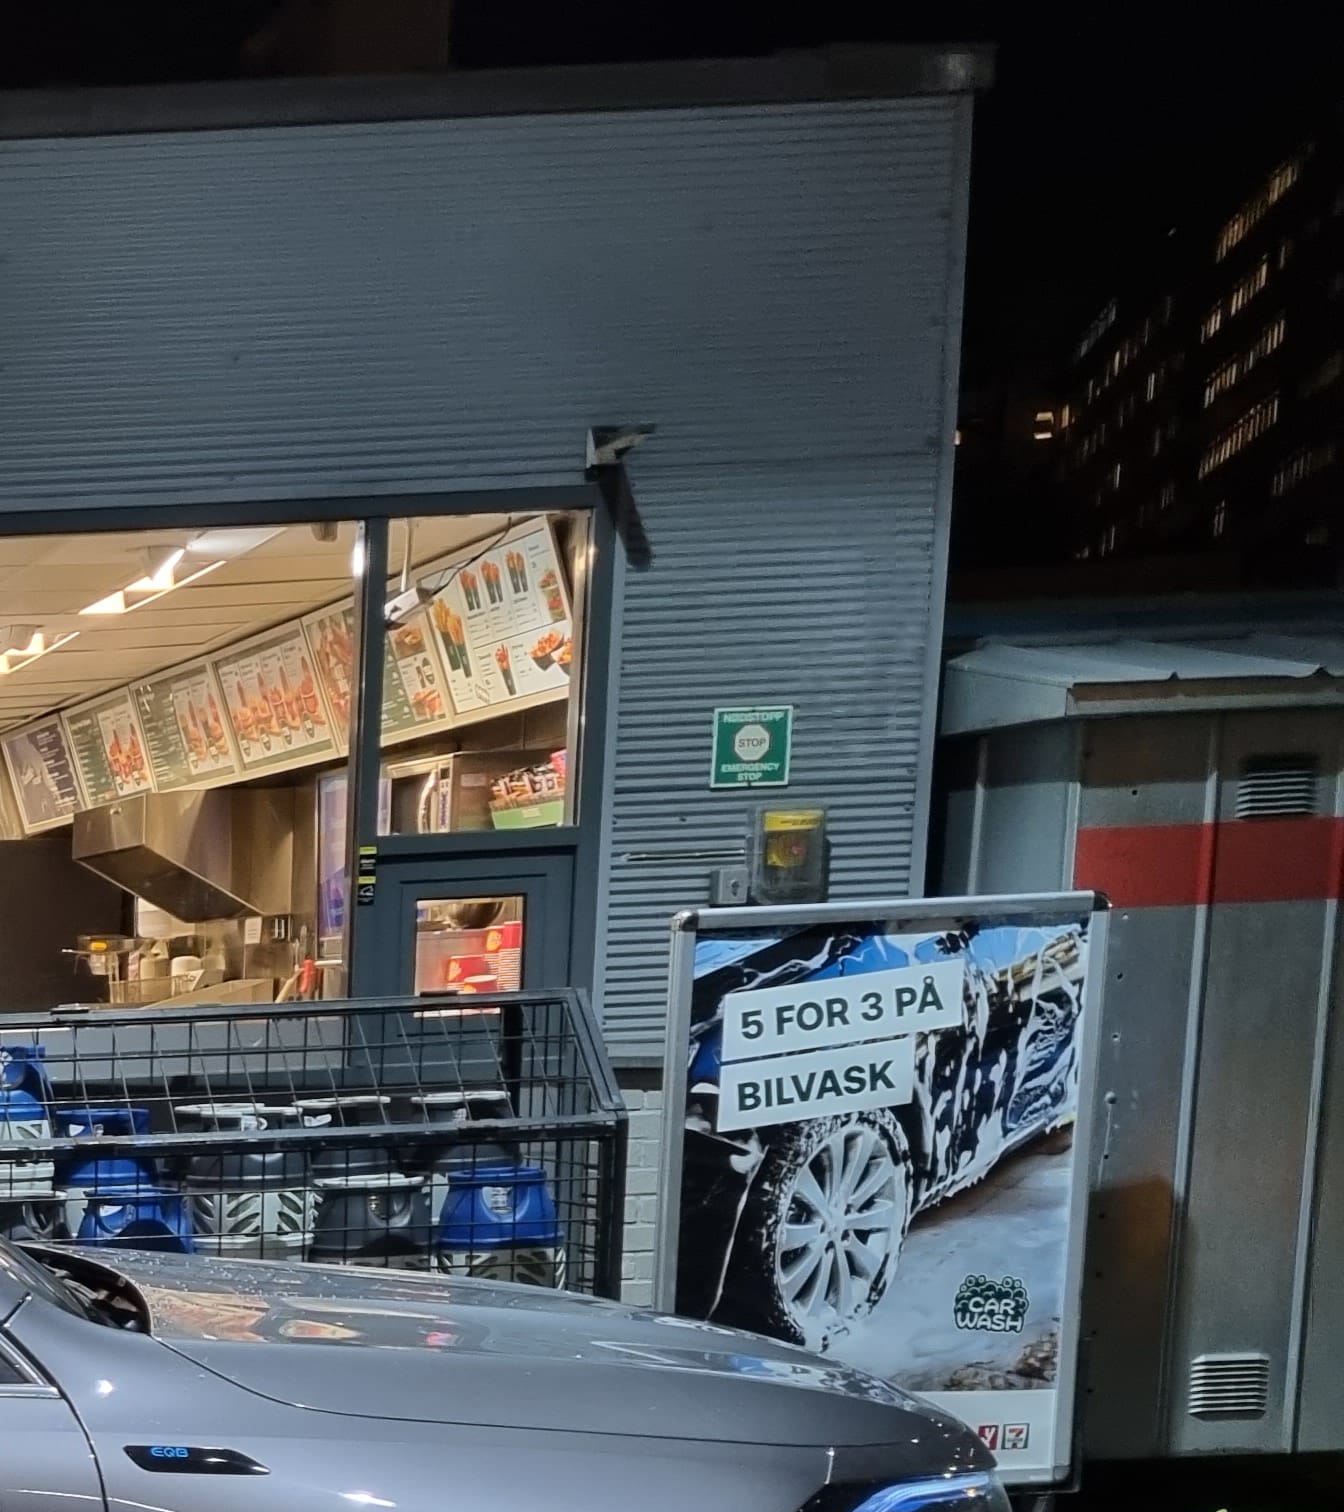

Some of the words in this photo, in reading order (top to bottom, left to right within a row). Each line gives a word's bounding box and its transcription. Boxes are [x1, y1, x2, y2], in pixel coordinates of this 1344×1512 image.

[738, 737, 767, 748] STOP
[721, 762, 780, 773] EMERGENCY
[737, 772, 763, 781] STOP
[741, 1009, 764, 1040] 5
[775, 997, 850, 1036] FOR
[860, 992, 884, 1022] 3
[894, 975, 944, 1017] PÅ
[737, 1059, 895, 1112] BILVASK
[968, 1296, 1016, 1315] CAR
[956, 1312, 1023, 1332] WASH
[151, 1447, 189, 1458] EQB
